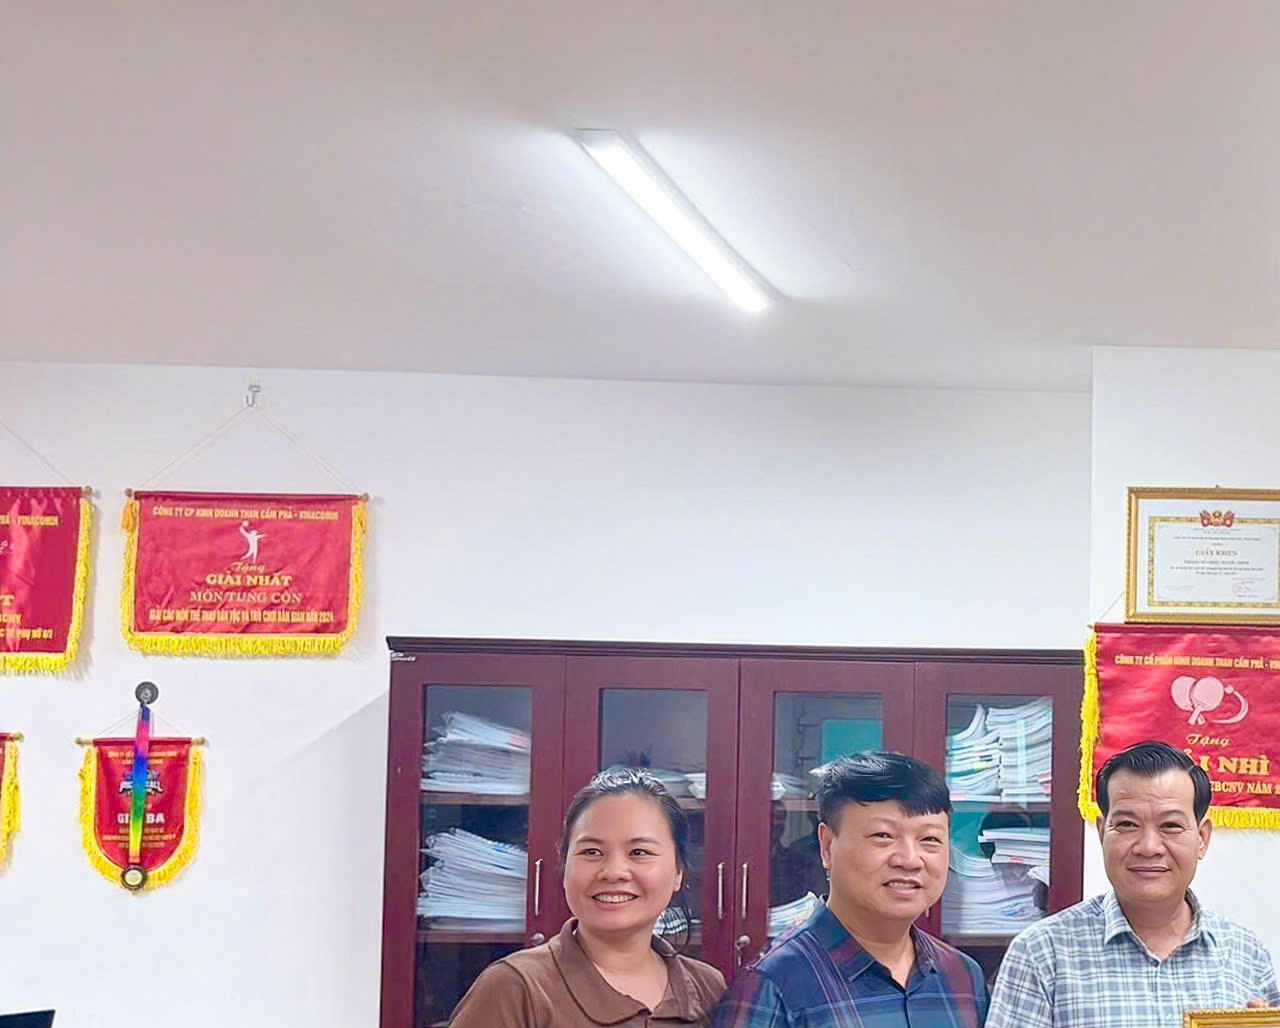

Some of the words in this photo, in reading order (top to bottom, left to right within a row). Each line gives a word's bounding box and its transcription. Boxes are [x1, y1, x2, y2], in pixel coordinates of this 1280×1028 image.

[184, 507, 195, 517] CP
[206, 571, 242, 585] GIẢI
[246, 572, 292, 586] NHẤT
[189, 589, 224, 602] MÔN
[225, 591, 267, 603] TUNG
[1186, 733, 1230, 747] Tặng
[1217, 754, 1271, 776] NHÌ
